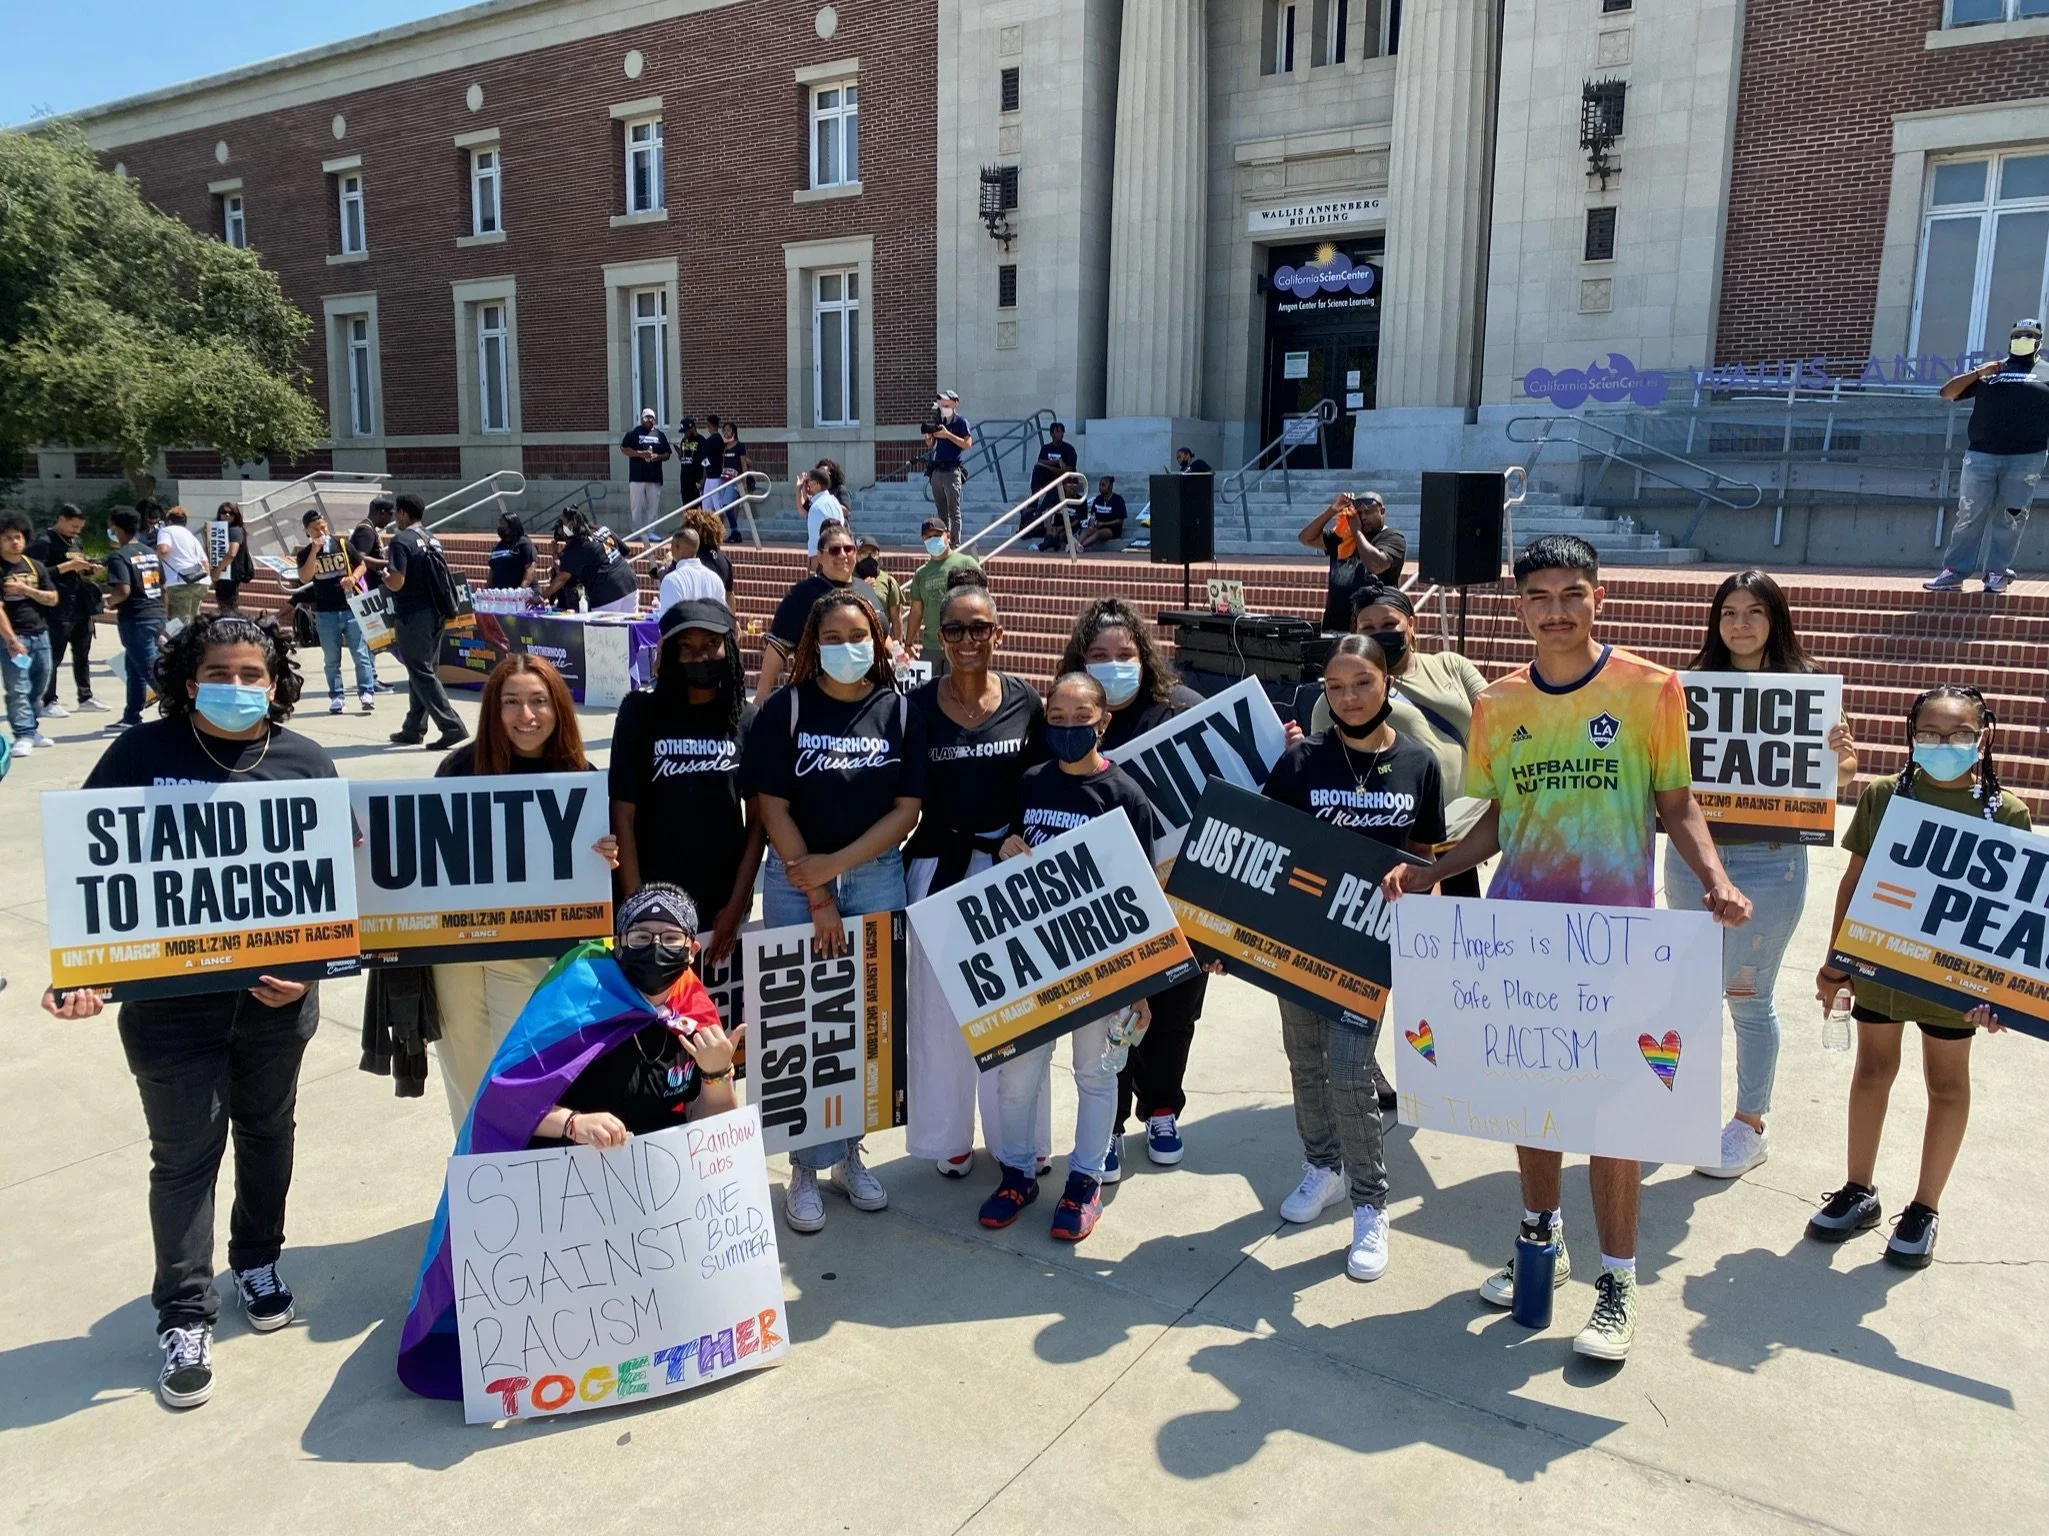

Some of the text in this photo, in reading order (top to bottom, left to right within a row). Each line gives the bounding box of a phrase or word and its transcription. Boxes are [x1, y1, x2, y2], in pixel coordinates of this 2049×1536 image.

[1262, 199, 1380, 219] WALLIS ANNENBERG
[1289, 213, 1349, 226] BUILDING
[1278, 296, 1375, 313] Amgen Center for Science Learning
[315, 553, 347, 575] ARC
[1593, 724, 1613, 737] LA
[1686, 685, 1826, 737] STICE
[654, 738, 737, 757] OTHERHOOD
[795, 750, 901, 777] Crusade
[797, 732, 890, 754] BROTHERHOOD
[976, 738, 1022, 757] EQUITY
[1690, 737, 1824, 790] EACE
[1118, 696, 1271, 842] NITY
[1023, 808, 1095, 829] BROTHERHO
[1310, 789, 1415, 811] BROTHERHOOD
[1735, 796, 1781, 812] AGAINST
[1784, 800, 1828, 815] RACISM
[86, 796, 319, 867] STAND UP
[368, 787, 589, 891] UNITY
[1185, 816, 1292, 896] JUSTICE
[1326, 872, 1392, 944] PEAC
[1889, 819, 2049, 909] JUST
[76, 857, 337, 935] TO RACISM
[956, 841, 1106, 946] RACISM
[359, 905, 604, 934] UNITY MARCH MOBILIZING AGAINST RACISM
[865, 920, 878, 962] RACISM
[1394, 903, 1673, 971] Los Angeles is NOT a
[1920, 883, 2049, 970] PEA
[61, 923, 354, 968] UNITY MARCH MOBILIZING AGAINST RACISM
[958, 885, 1151, 1009] IS A VIRUS
[1196, 909, 1234, 937] MARCH
[1233, 928, 1291, 963] MOBILIZING
[1291, 953, 1338, 983] AGAINST
[1337, 972, 1382, 1002] RACISM
[1835, 954, 1852, 965] PLAY
[1847, 923, 2049, 1002] UNITY MARCH MOBILIZING AGAIN
[865, 963, 878, 1005] AGAINST
[968, 932, 1179, 1039] UNITY MARCH MOBILIZING AGAINST RACISM
[1452, 979, 1616, 1013] Safe Place For
[758, 939, 808, 1137] JUSTICE
[865, 1005, 878, 1059] MOBILIZING
[1484, 1023, 1600, 1072] RACISM
[866, 1058, 879, 1097] MARCH
[980, 1053, 994, 1064] PLAY
[686, 1119, 757, 1171] Rainbow
[698, 1153, 735, 1181] Labs
[466, 1140, 682, 1254] STAND
[694, 1180, 741, 1222] ONE
[706, 1206, 764, 1251] BOLD
[458, 1217, 692, 1315] AGAINST
[472, 1287, 663, 1384] RACISM
[485, 1307, 784, 1418] TOGETHER
